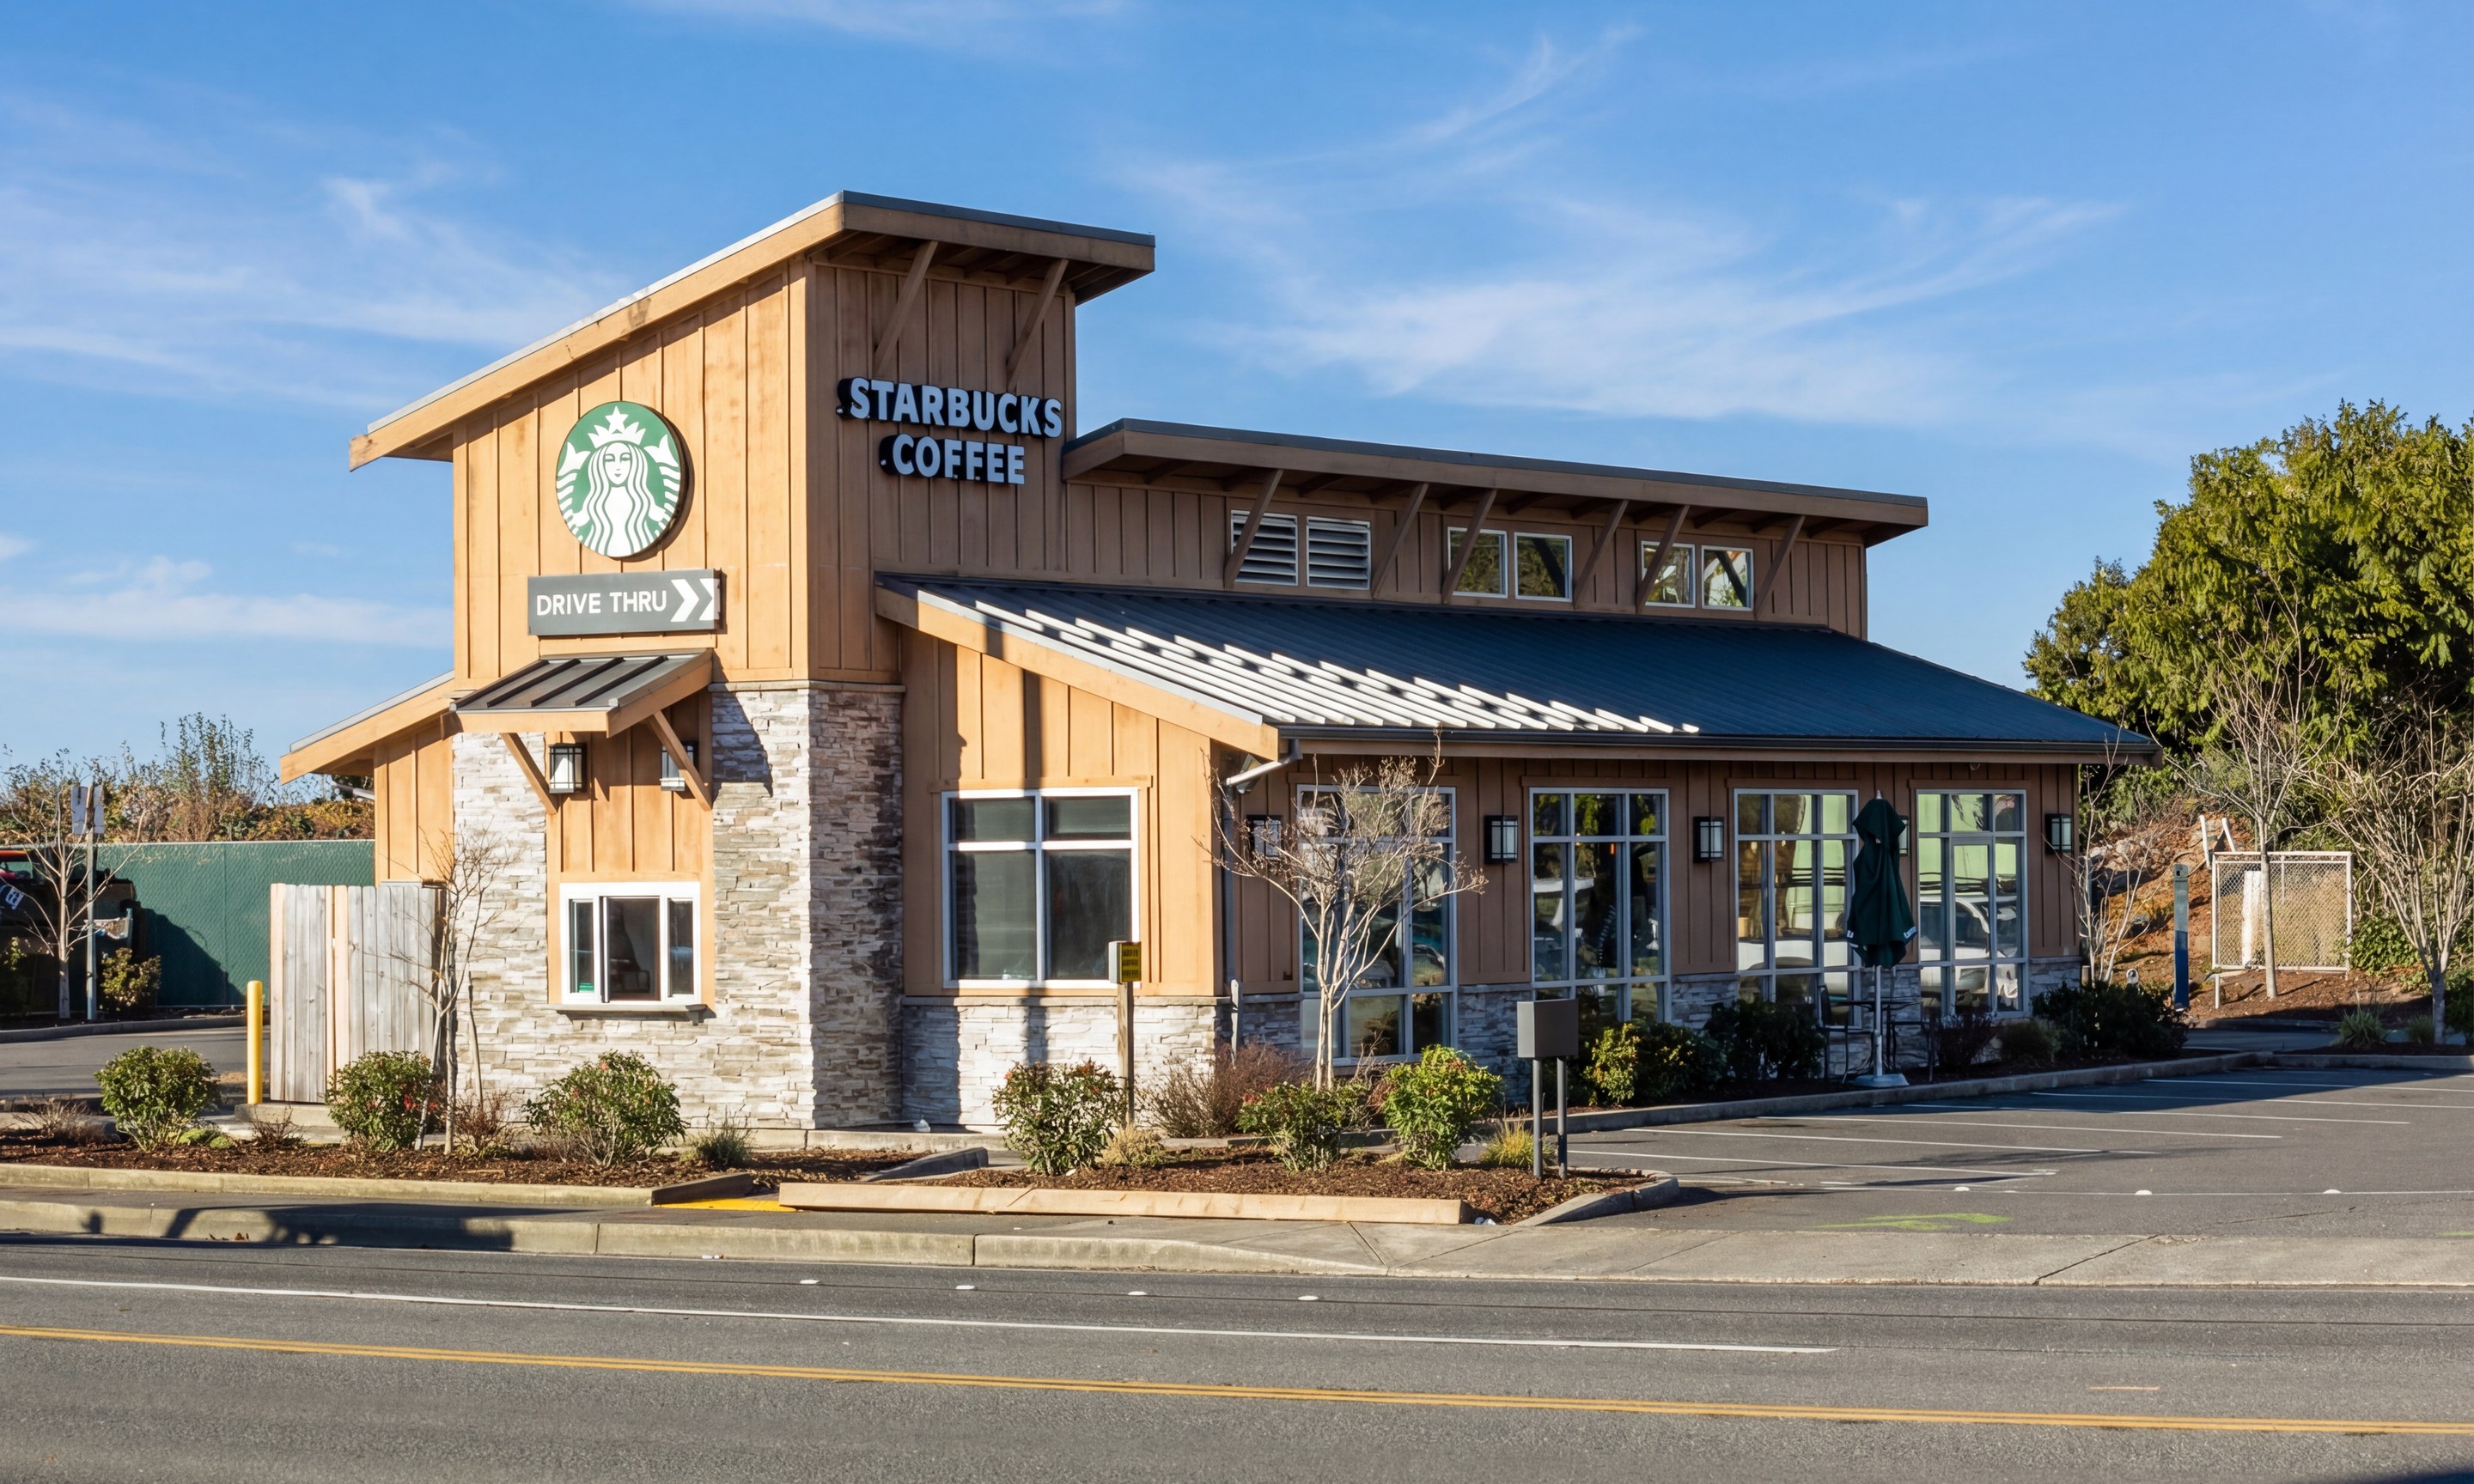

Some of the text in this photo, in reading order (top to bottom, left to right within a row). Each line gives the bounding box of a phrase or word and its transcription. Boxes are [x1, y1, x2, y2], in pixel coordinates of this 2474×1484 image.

[850, 376, 1063, 439] STARBUCKS
[892, 433, 1025, 485] COFFEE
[536, 590, 667, 616] DRIVE THRU
